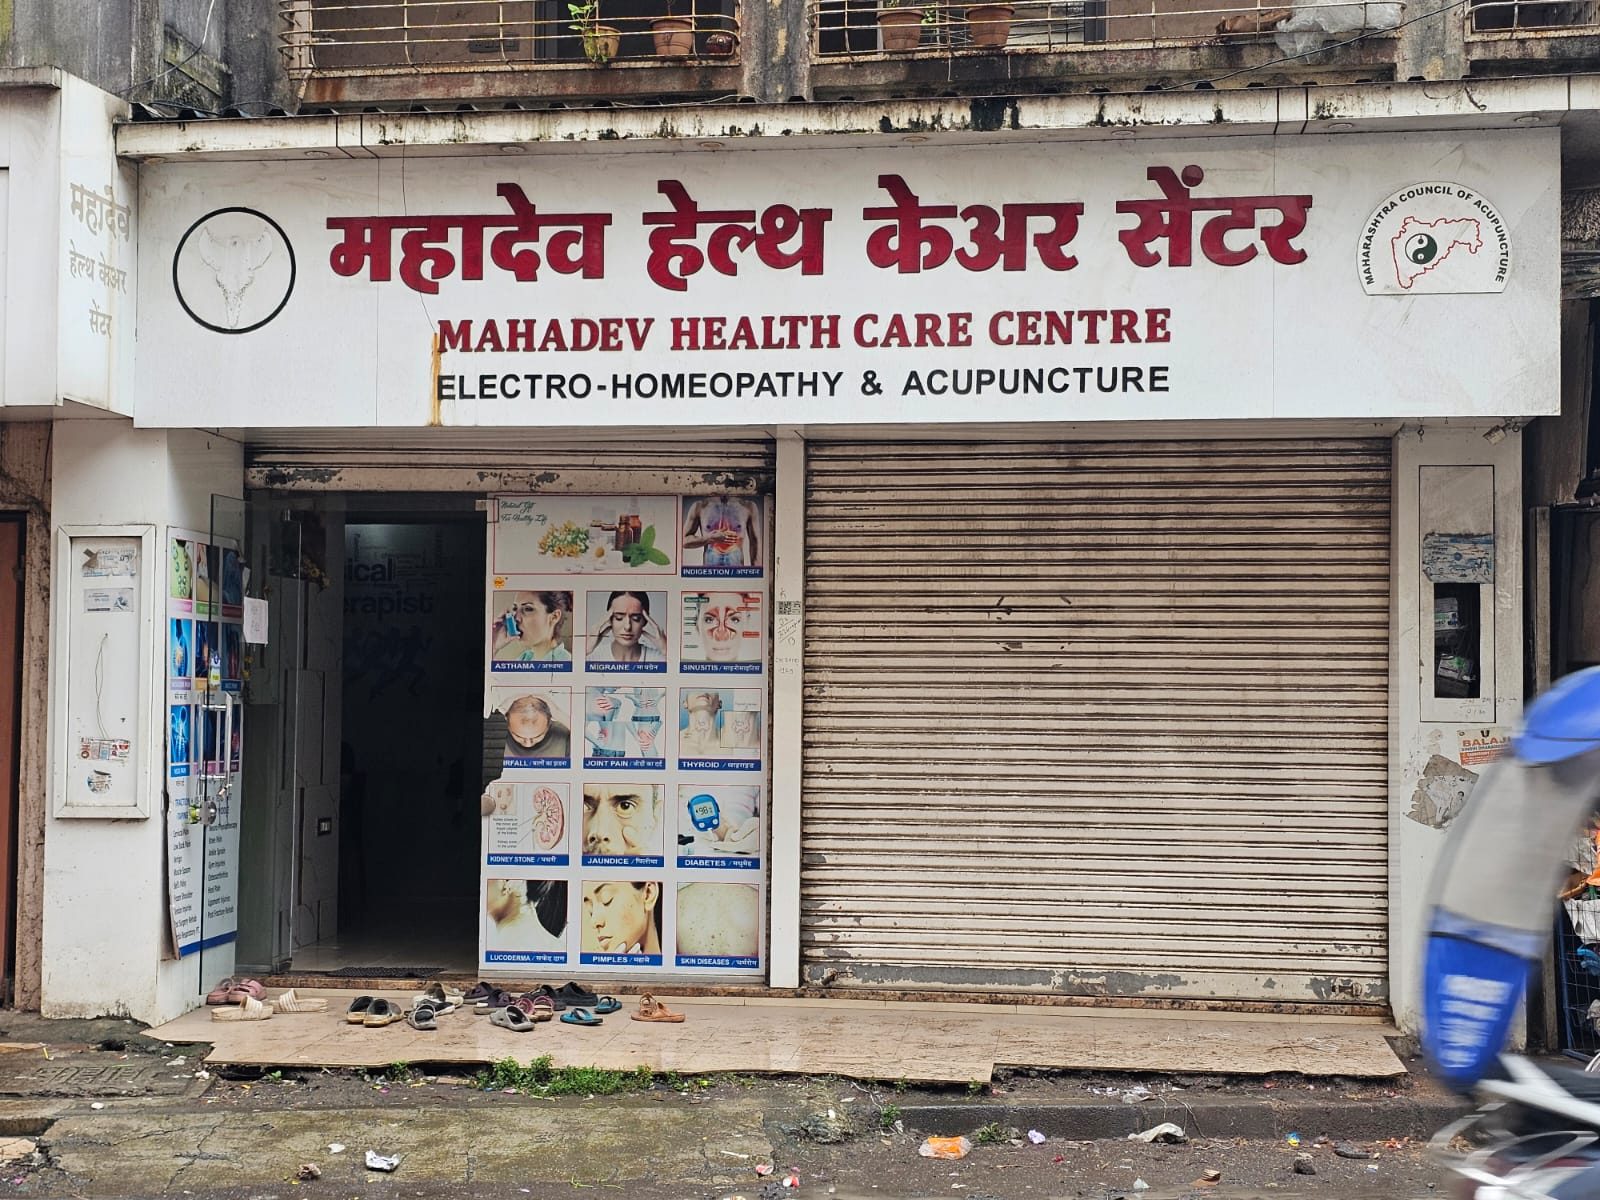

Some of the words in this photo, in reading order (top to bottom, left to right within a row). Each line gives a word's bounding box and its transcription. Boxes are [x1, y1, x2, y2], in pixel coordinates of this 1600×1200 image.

[70, 183, 131, 242] महादेव
[327, 182, 612, 294] महादेव
[643, 179, 831, 291] हेल्थ
[864, 174, 1084, 273] केअर
[1117, 164, 1313, 268] सेंटर
[1361, 201, 1398, 285] MAHARASHTRA
[1399, 185, 1453, 202] COUNCIL
[1457, 190, 1473, 200] OF
[1473, 200, 1509, 283] ACUPUNCTURE
[69, 239, 96, 280] हेल्थ
[99, 252, 127, 294] केअर
[89, 299, 112, 339] सेंटर
[438, 317, 655, 353] MAHADEV
[671, 314, 841, 350] HEALTH
[854, 312, 972, 347] CARE
[989, 309, 1171, 345] CENTRE
[438, 370, 843, 400] ELECTRO-HOMEOPATHY
[861, 370, 882, 396] &
[902, 366, 1170, 396] ACUPUNCTURE
[345, 557, 393, 582] ical
[684, 859, 726, 867] DIABETES
[592, 955, 628, 963] PIMPLES
[680, 957, 696, 965] SKIN
[697, 958, 730, 966] DISEASES
